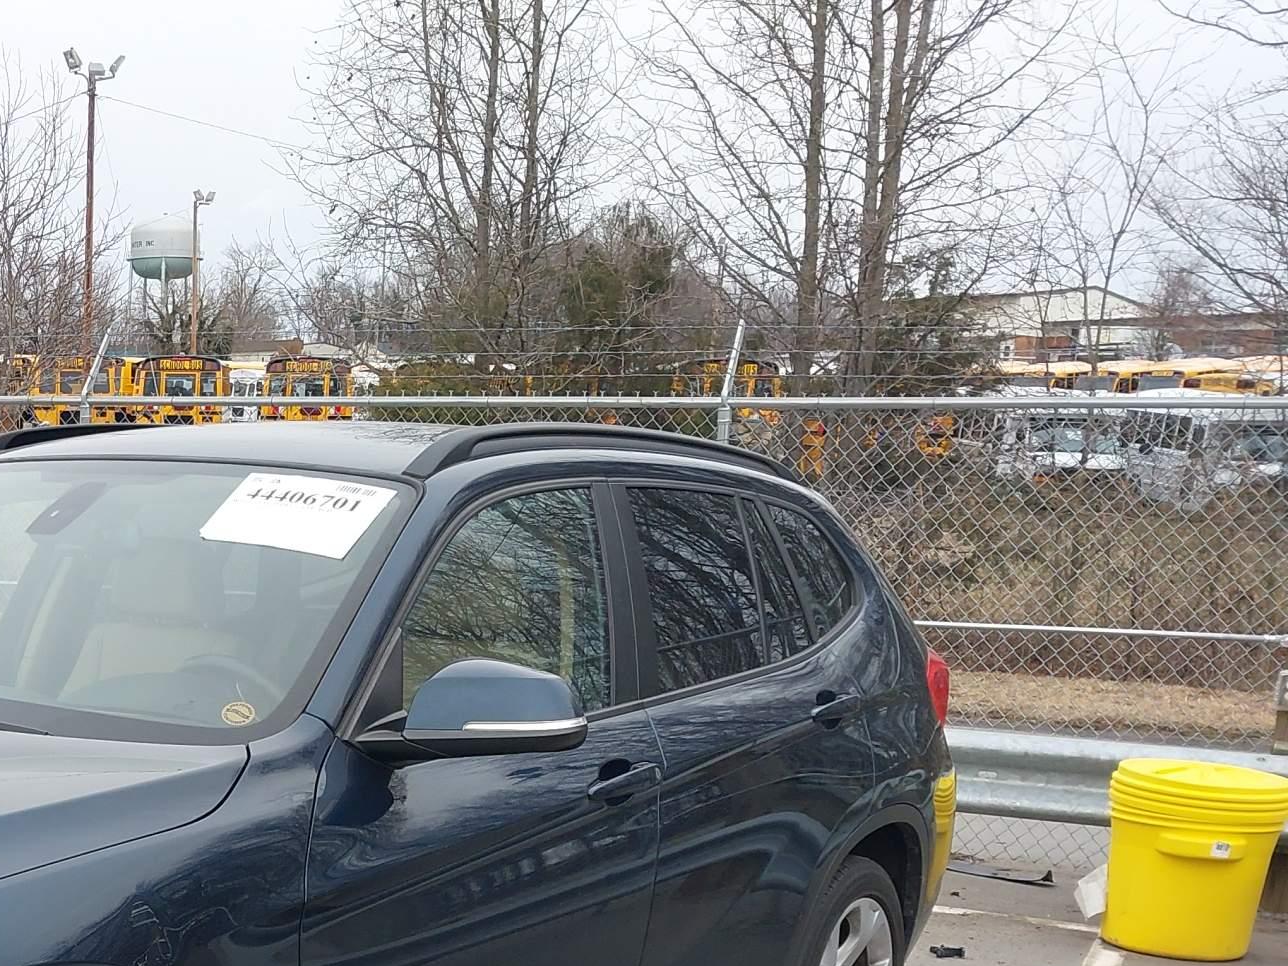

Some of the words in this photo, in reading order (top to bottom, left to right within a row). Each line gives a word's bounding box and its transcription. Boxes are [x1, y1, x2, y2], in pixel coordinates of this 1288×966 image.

[160, 359, 188, 370] SCHOOL
[189, 359, 202, 370] BUS
[287, 361, 317, 372] SCHOOL
[247, 488, 362, 512] 44406701
